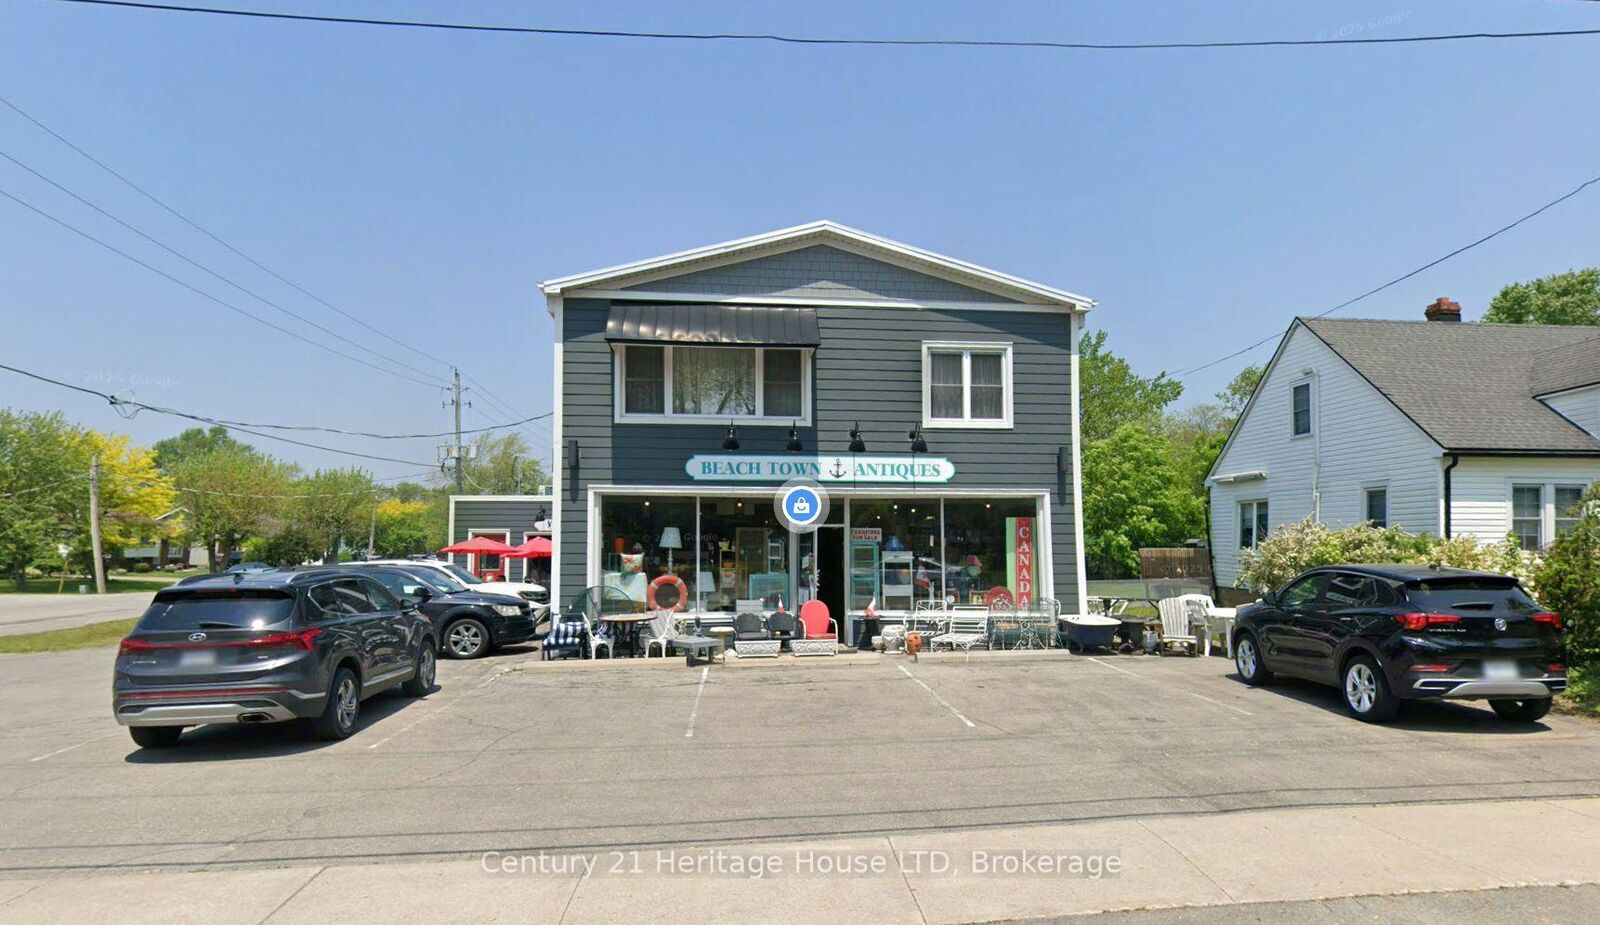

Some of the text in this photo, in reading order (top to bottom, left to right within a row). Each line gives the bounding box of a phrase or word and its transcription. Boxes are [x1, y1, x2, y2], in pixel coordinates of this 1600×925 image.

[701, 461, 941, 480] BEACH TOWN ANTIQUES
[1019, 526, 1031, 608] CANADA
